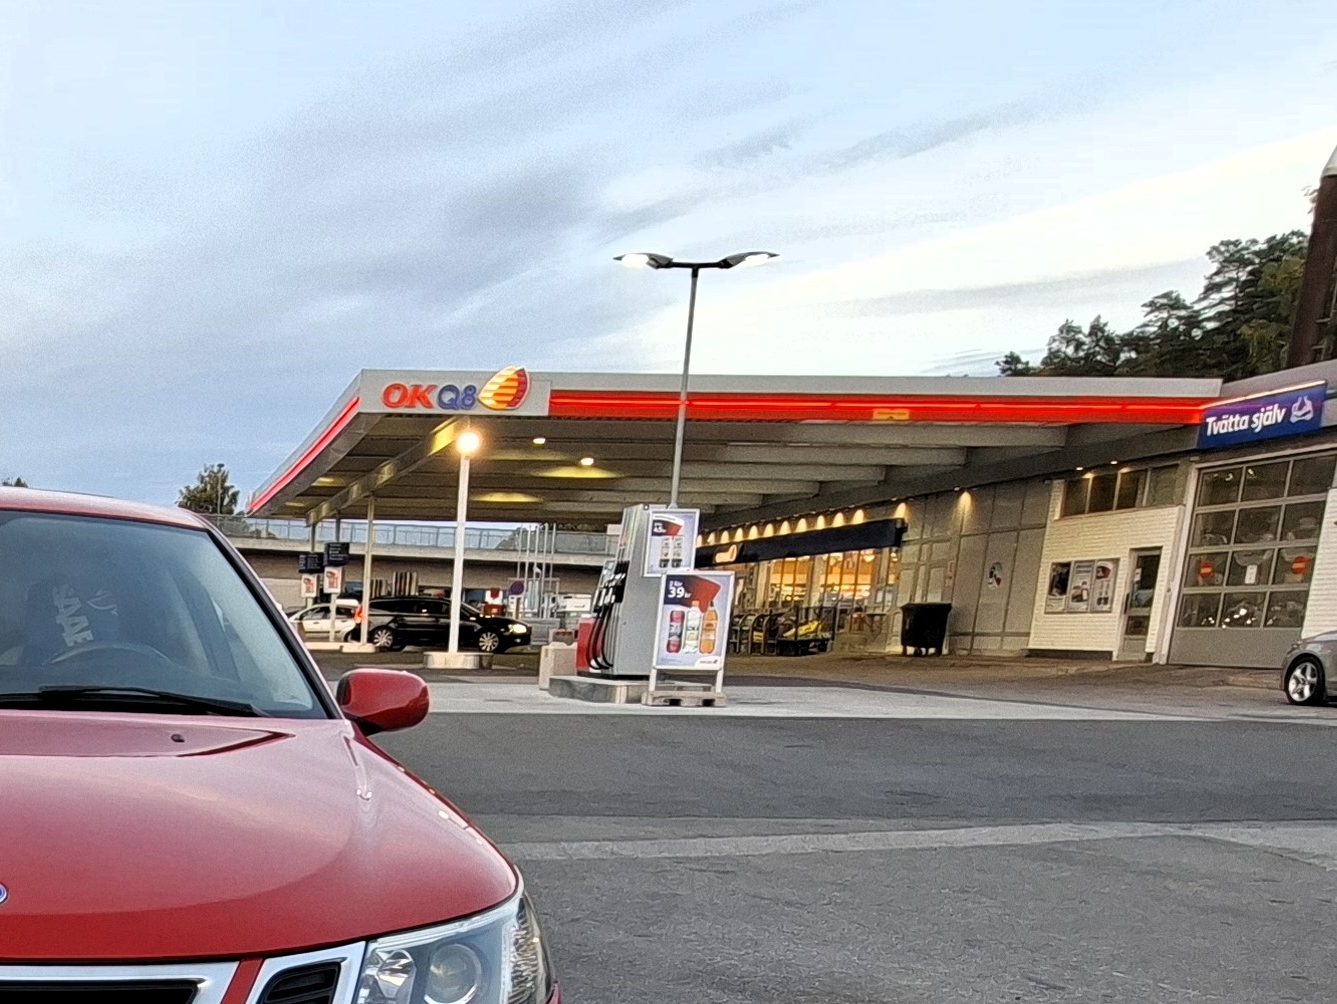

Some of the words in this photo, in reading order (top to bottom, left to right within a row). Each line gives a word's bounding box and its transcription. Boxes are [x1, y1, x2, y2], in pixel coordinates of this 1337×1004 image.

[1205, 413, 1249, 437] Tvätta
[1250, 403, 1287, 433] själv
[667, 586, 685, 599] 39
